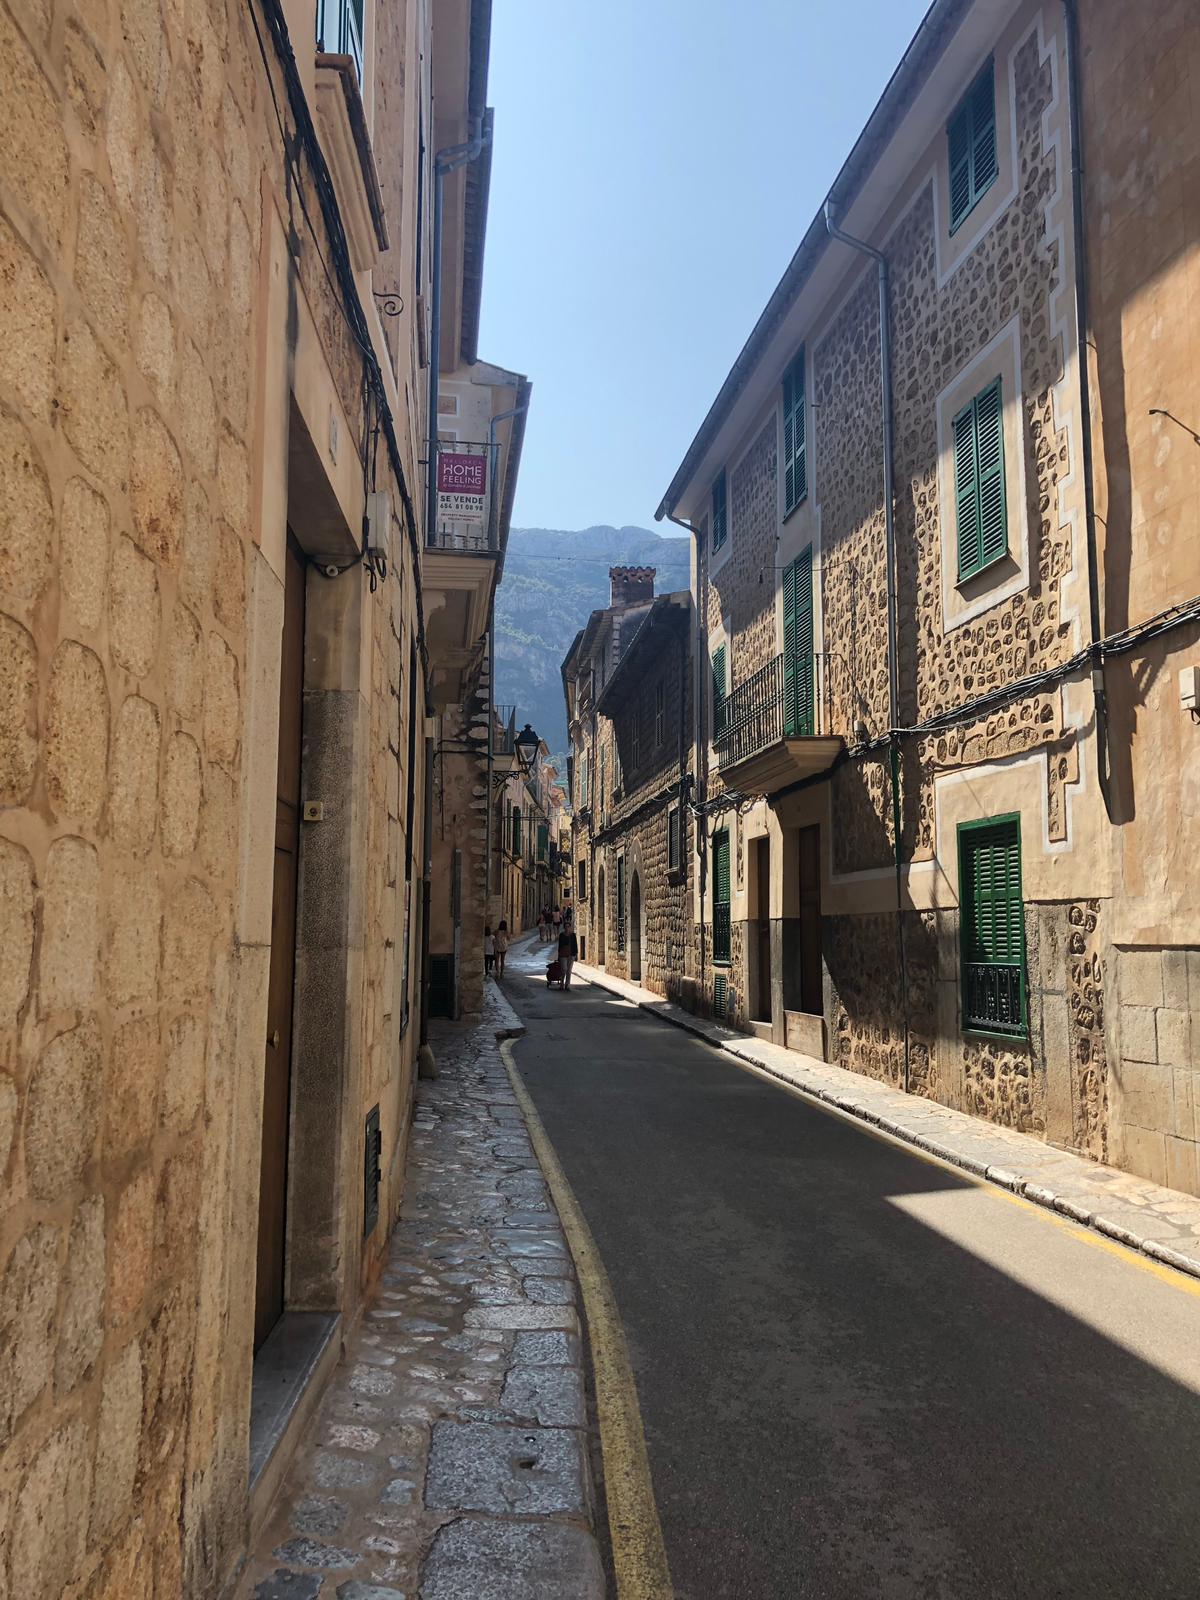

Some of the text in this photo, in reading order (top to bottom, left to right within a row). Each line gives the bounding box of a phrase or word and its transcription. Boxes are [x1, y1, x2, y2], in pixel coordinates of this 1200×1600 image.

[443, 463, 482, 476] HOME
[443, 475, 482, 485] FEELING
[453, 496, 484, 505] VENDE
